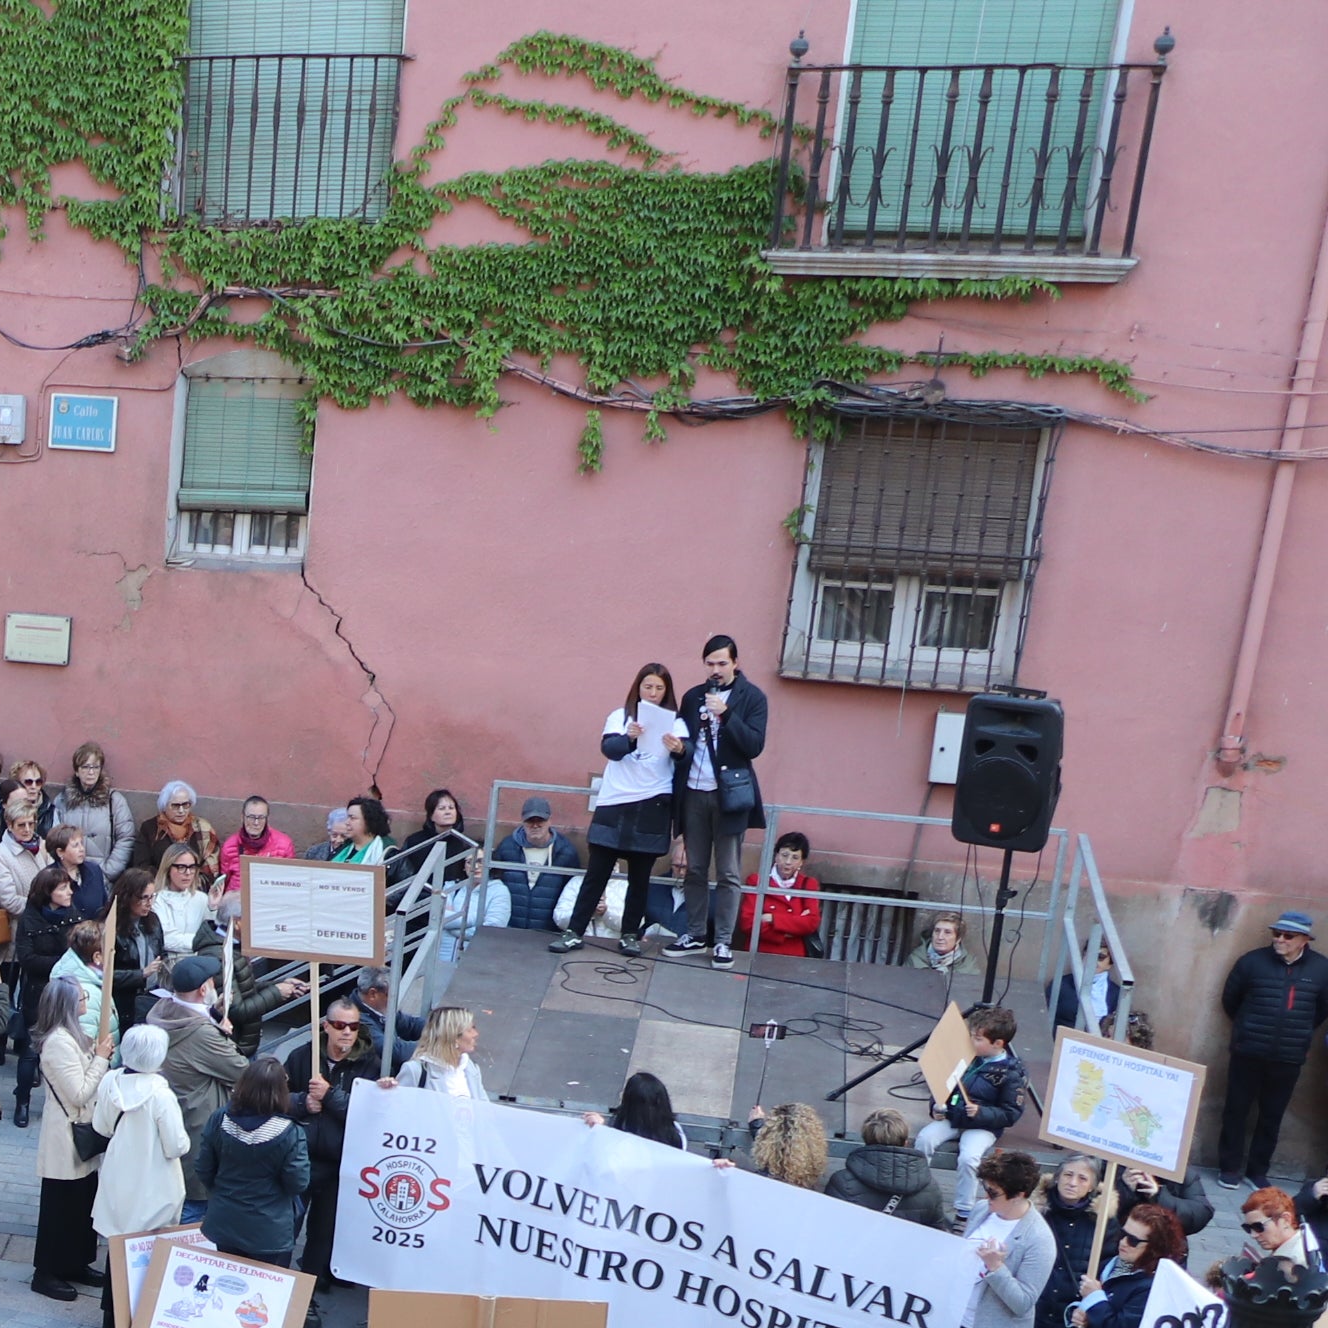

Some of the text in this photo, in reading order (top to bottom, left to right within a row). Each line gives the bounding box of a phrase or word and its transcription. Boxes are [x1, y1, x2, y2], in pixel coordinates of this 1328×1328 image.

[53, 424, 73, 440] JUAN
[76, 426, 105, 442] CARLOS
[271, 880, 302, 888] SANIDAD
[274, 924, 367, 941] SE DEFIENDE
[1112, 1056, 1123, 1067] TU
[1124, 1060, 1164, 1079] HOSPITAL
[382, 1132, 437, 1154] 2012
[386, 1160, 427, 1176] HOSPITAL
[376, 1202, 427, 1224] CALAHORRA
[473, 1163, 705, 1252] VOLVEMOS
[711, 1234, 740, 1270] A
[372, 1225, 425, 1249] 2025
[474, 1213, 664, 1291] NUESTRO
[175, 1250, 284, 1283] DECAPITAR ES ELIMINAR
